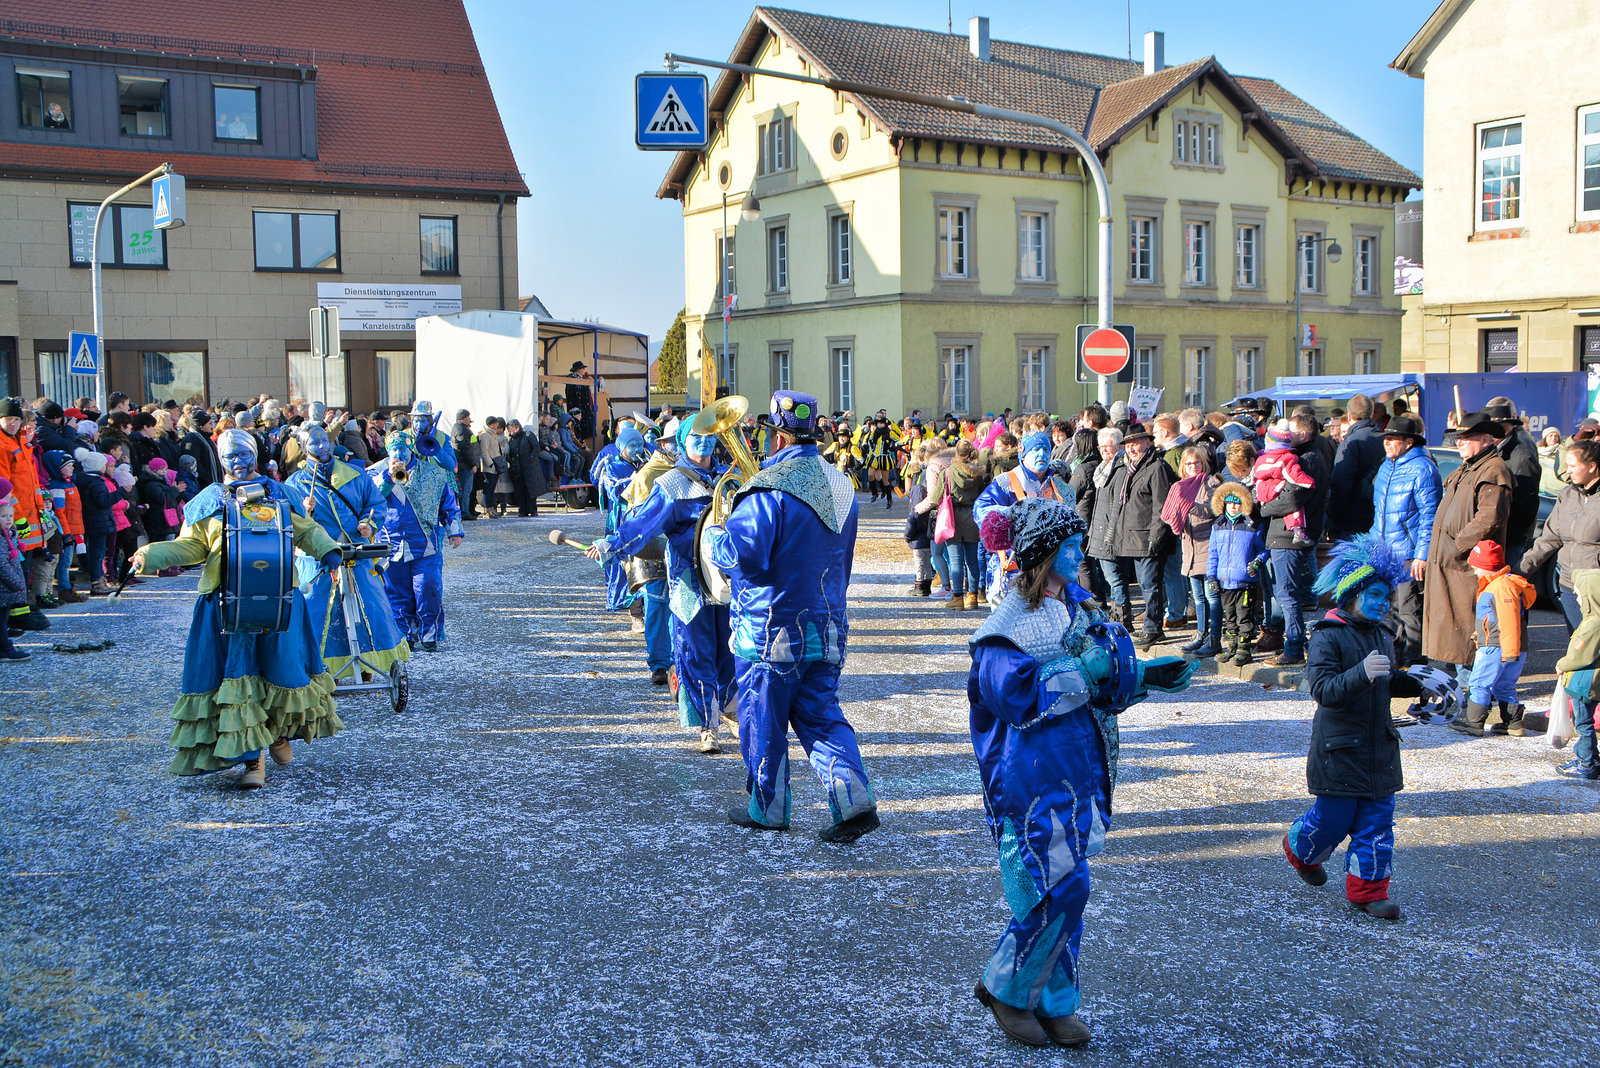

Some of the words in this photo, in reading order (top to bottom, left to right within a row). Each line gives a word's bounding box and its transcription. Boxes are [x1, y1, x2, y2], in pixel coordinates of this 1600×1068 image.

[74, 221, 84, 262] BADER
[129, 230, 153, 247] 25
[131, 246, 156, 256] Jahre
[344, 287, 437, 298] Dienstleistungszentrum
[362, 322, 415, 330] Kanzleistraße
